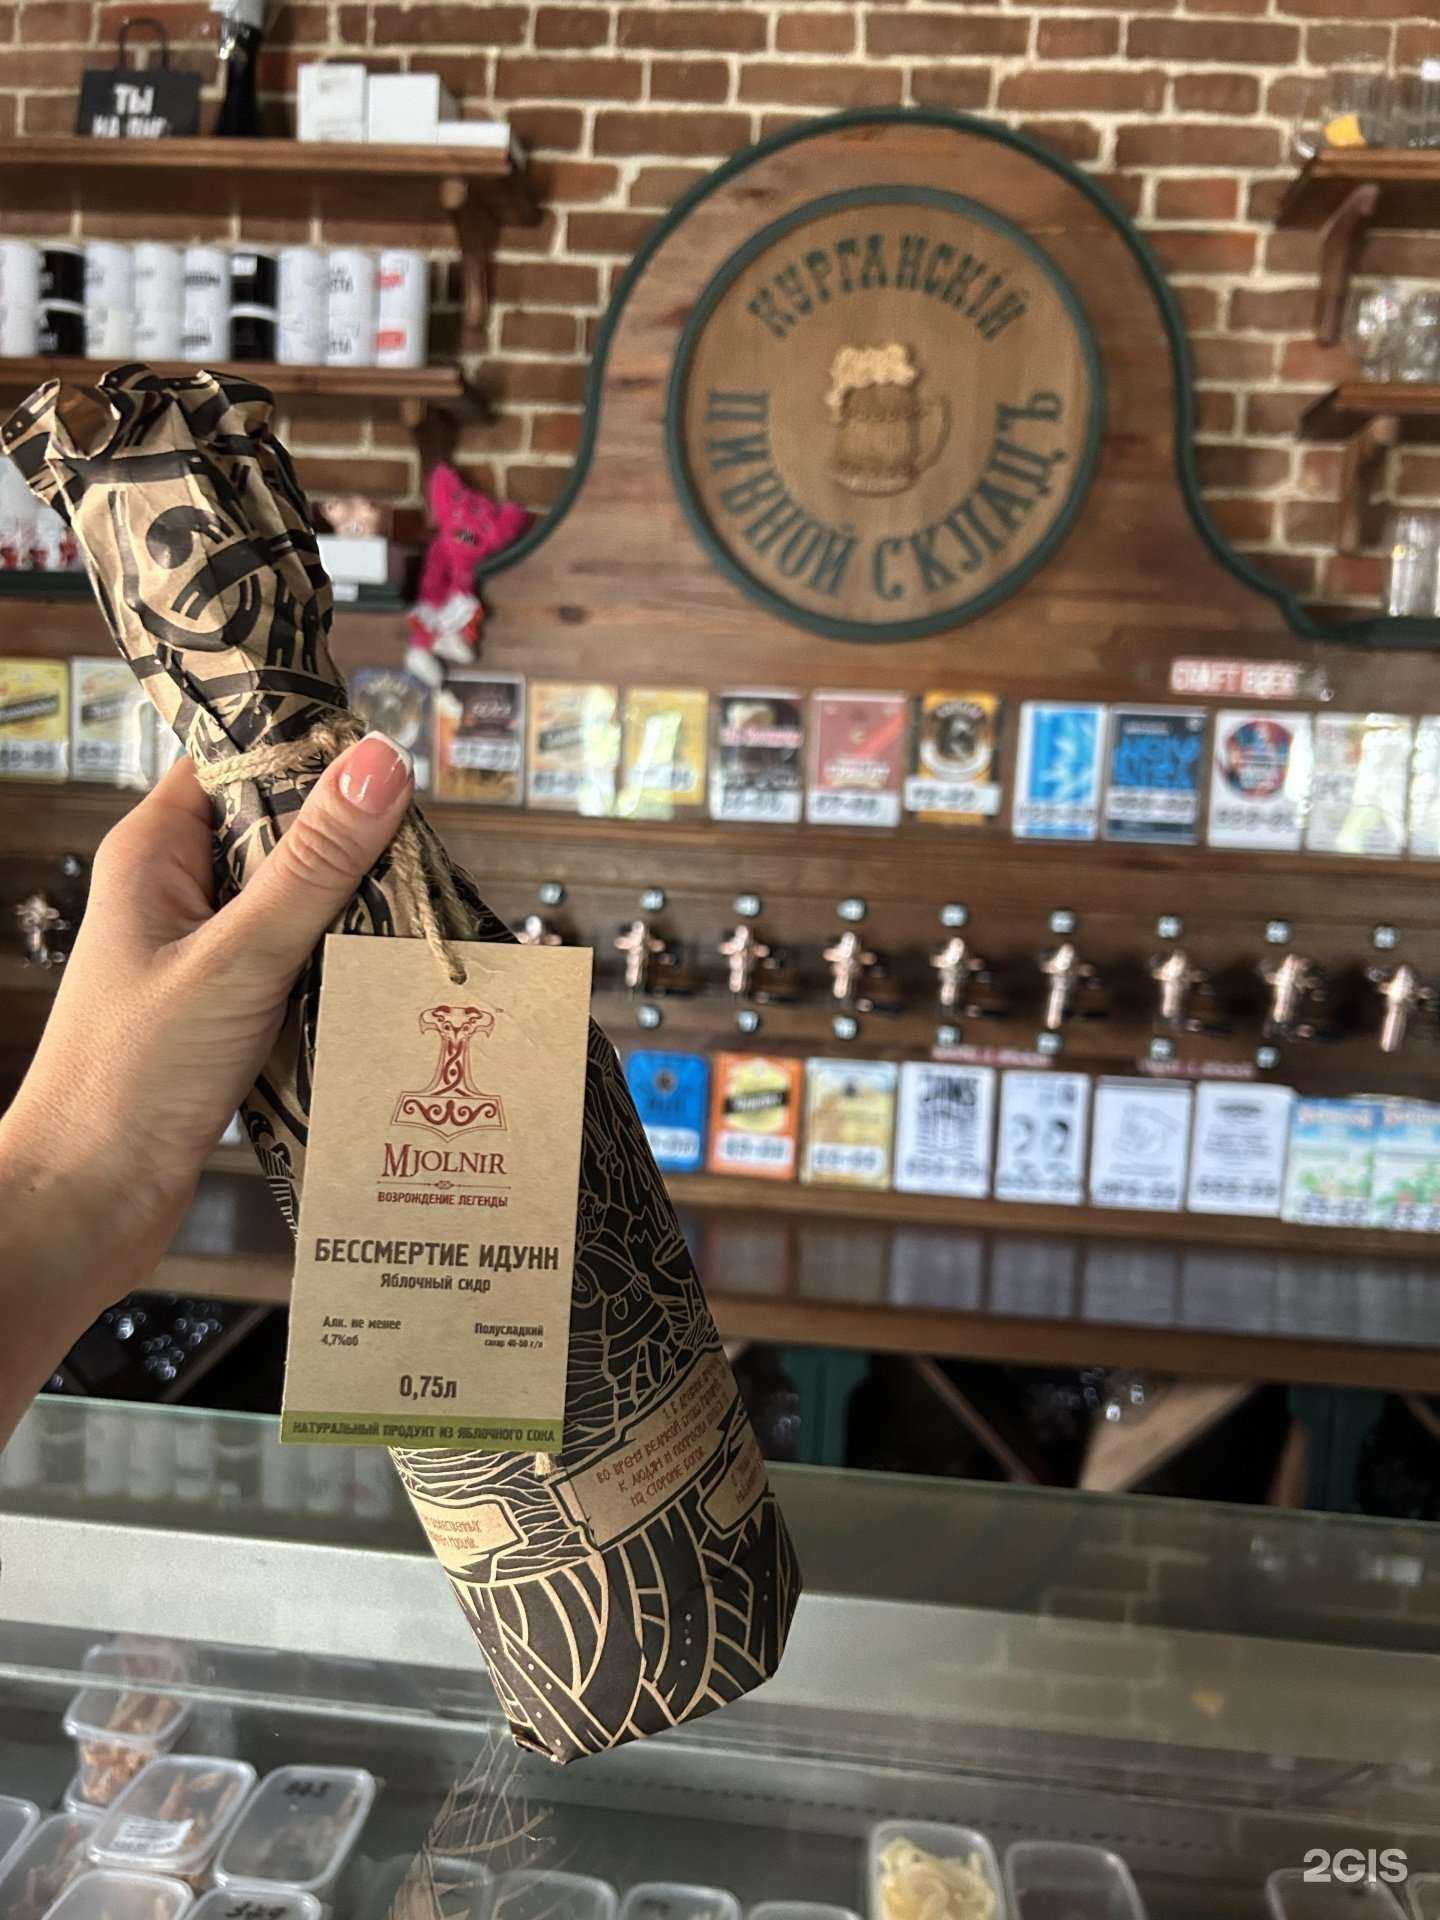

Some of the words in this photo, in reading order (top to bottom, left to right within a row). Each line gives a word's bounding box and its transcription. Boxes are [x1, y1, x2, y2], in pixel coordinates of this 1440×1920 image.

[114, 83, 154, 115] ТЫ
[704, 387, 860, 599] ПИВНОЙ
[870, 390, 1065, 601] СКЛАДЪ
[377, 1191, 455, 1206] ВОЗРОЖДЕНИЕ
[457, 1193, 508, 1208] ЛЕГЕНДЫ
[314, 1237, 469, 1267] БЕССМЕРТИЕ
[479, 1245, 560, 1272] ИДУНН
[380, 1273, 453, 1291] Яблочный
[458, 1277, 491, 1293] сидр
[322, 1315, 348, 1329] Алк.
[351, 1318, 365, 1329] не
[368, 1319, 402, 1330] менее
[474, 1322, 544, 1337] Полусладкий
[321, 1333, 359, 1347] 4,7%об
[399, 1374, 458, 1401] 0,75л
[292, 1421, 380, 1436] НАТУРАЛЬНЫЙ
[382, 1424, 436, 1439] ПРОДУКТ
[438, 1426, 454, 1438] ИЗ
[457, 1427, 524, 1442] ЯБЛОЧНОГО
[526, 1429, 556, 1443] СОКА
